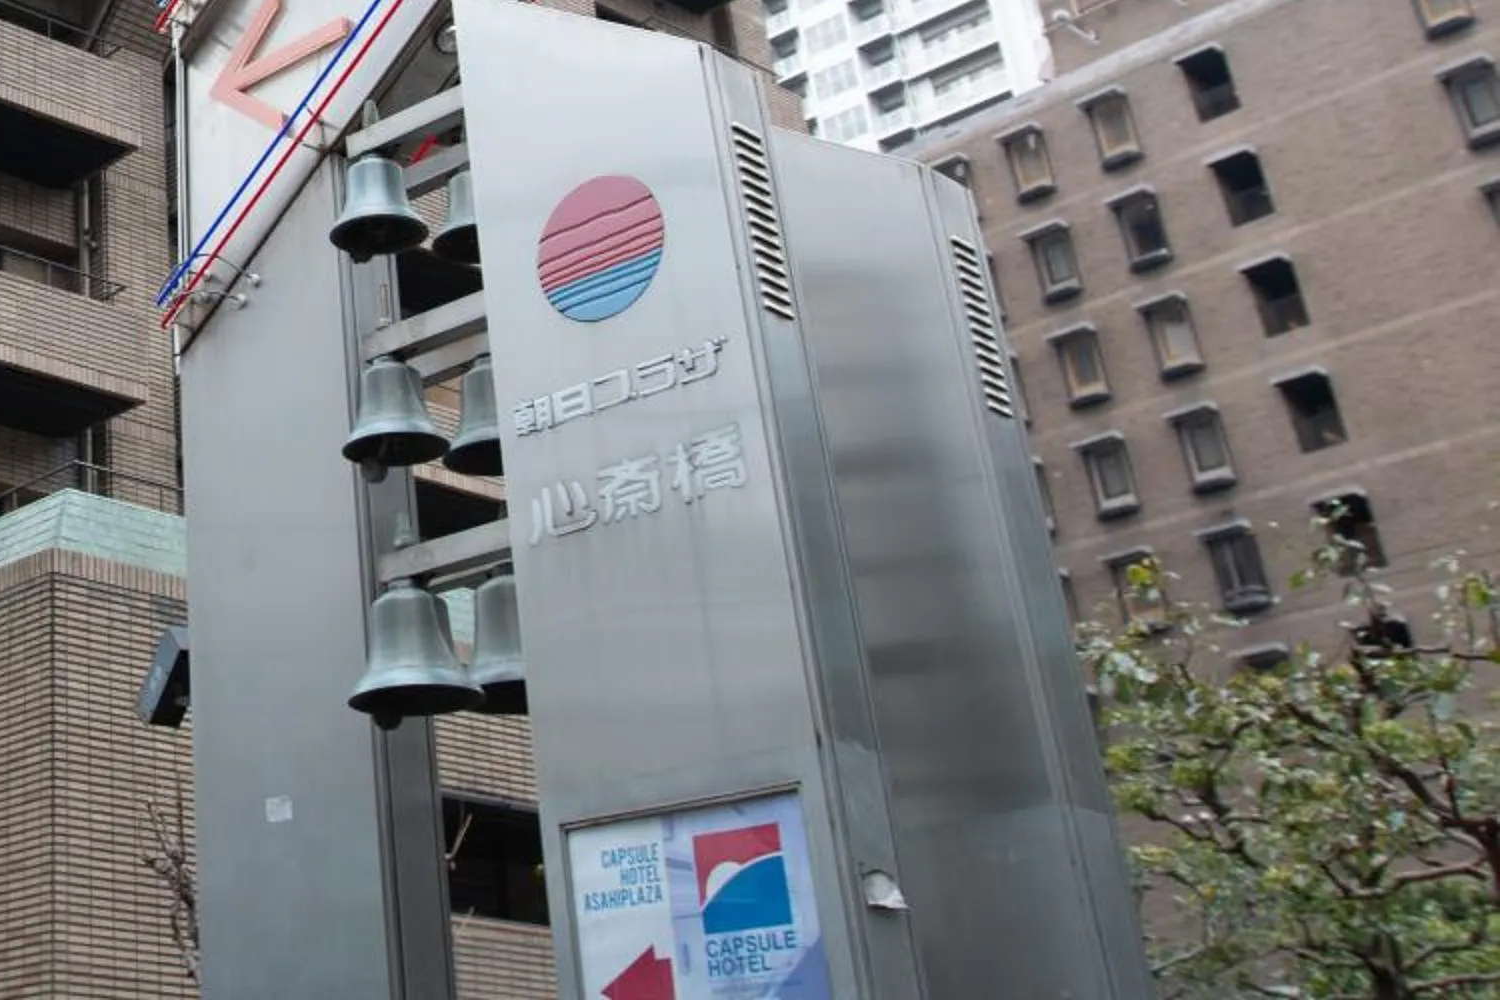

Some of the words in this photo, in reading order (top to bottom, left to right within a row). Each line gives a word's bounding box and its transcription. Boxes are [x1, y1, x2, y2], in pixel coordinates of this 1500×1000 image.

[512, 335, 729, 437] 朝日プラザ
[528, 421, 747, 546] 心斎橋
[601, 843, 659, 868] CAPSULE
[620, 865, 661, 885] HOTEL
[706, 931, 797, 958] CAPSULE
[708, 956, 772, 977] HOTEL
